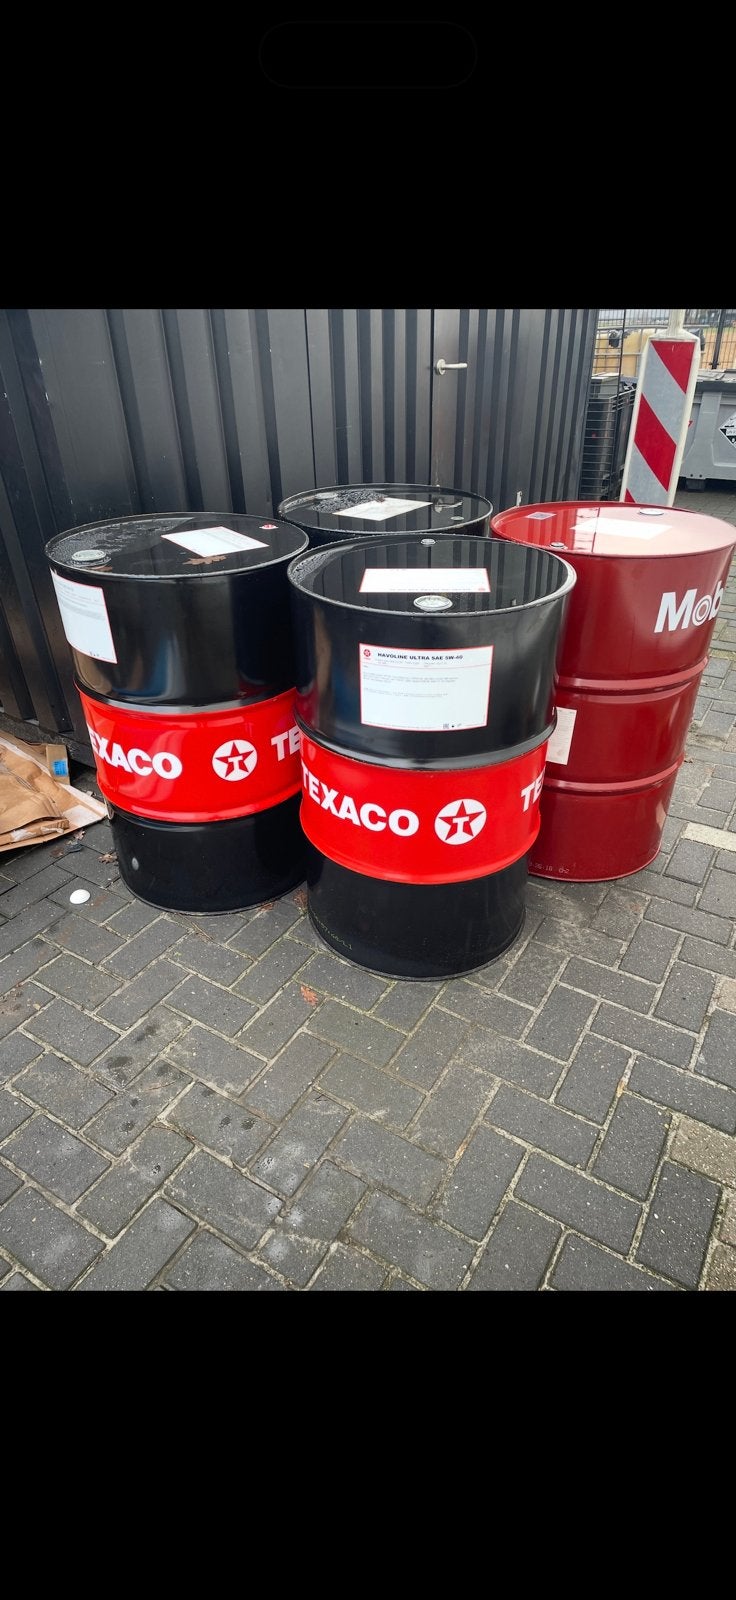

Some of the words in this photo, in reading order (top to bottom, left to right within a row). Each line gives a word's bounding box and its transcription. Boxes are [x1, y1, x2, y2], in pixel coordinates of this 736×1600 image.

[377, 652, 408, 660] HAVOLINE
[86, 722, 183, 780] EXACO
[301, 758, 419, 837] TEXACO
